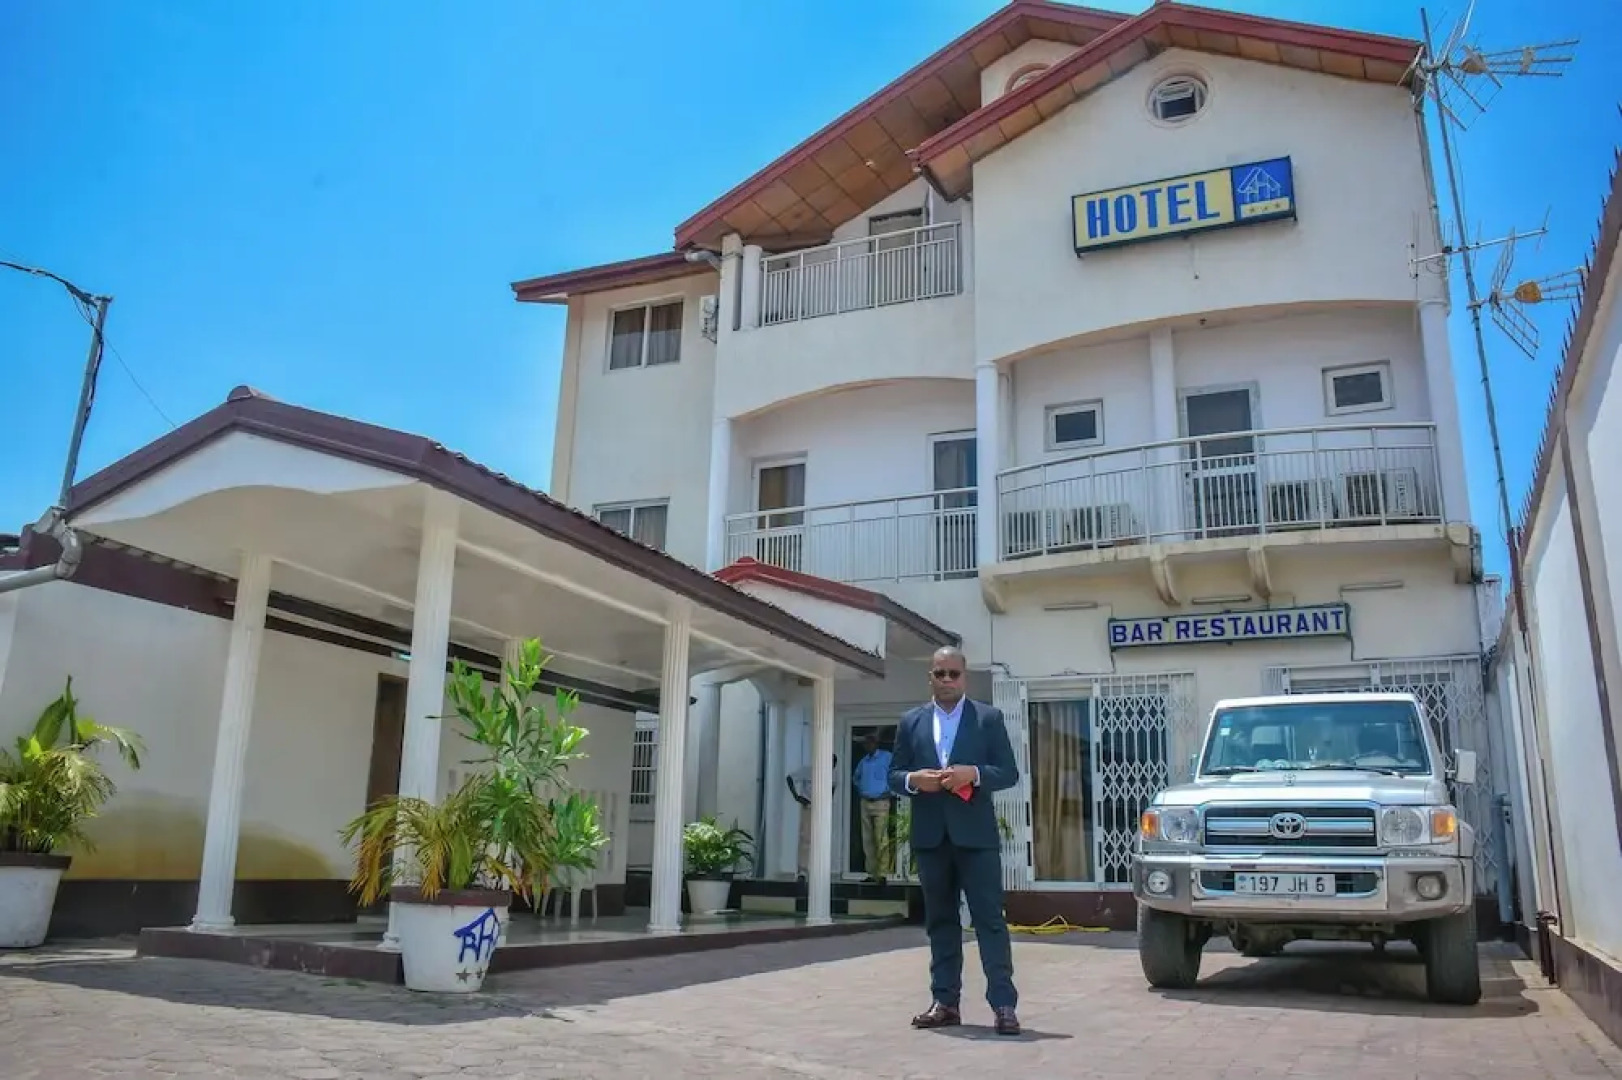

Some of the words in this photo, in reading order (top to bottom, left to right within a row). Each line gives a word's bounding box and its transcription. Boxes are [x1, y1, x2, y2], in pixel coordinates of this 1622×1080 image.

[1086, 180, 1220, 239] HOTEL
[1112, 622, 1163, 644] BAR
[1175, 609, 1344, 640] RESTAURANT
[1288, 876, 1308, 893] JH
[1316, 876, 1326, 893] 6
